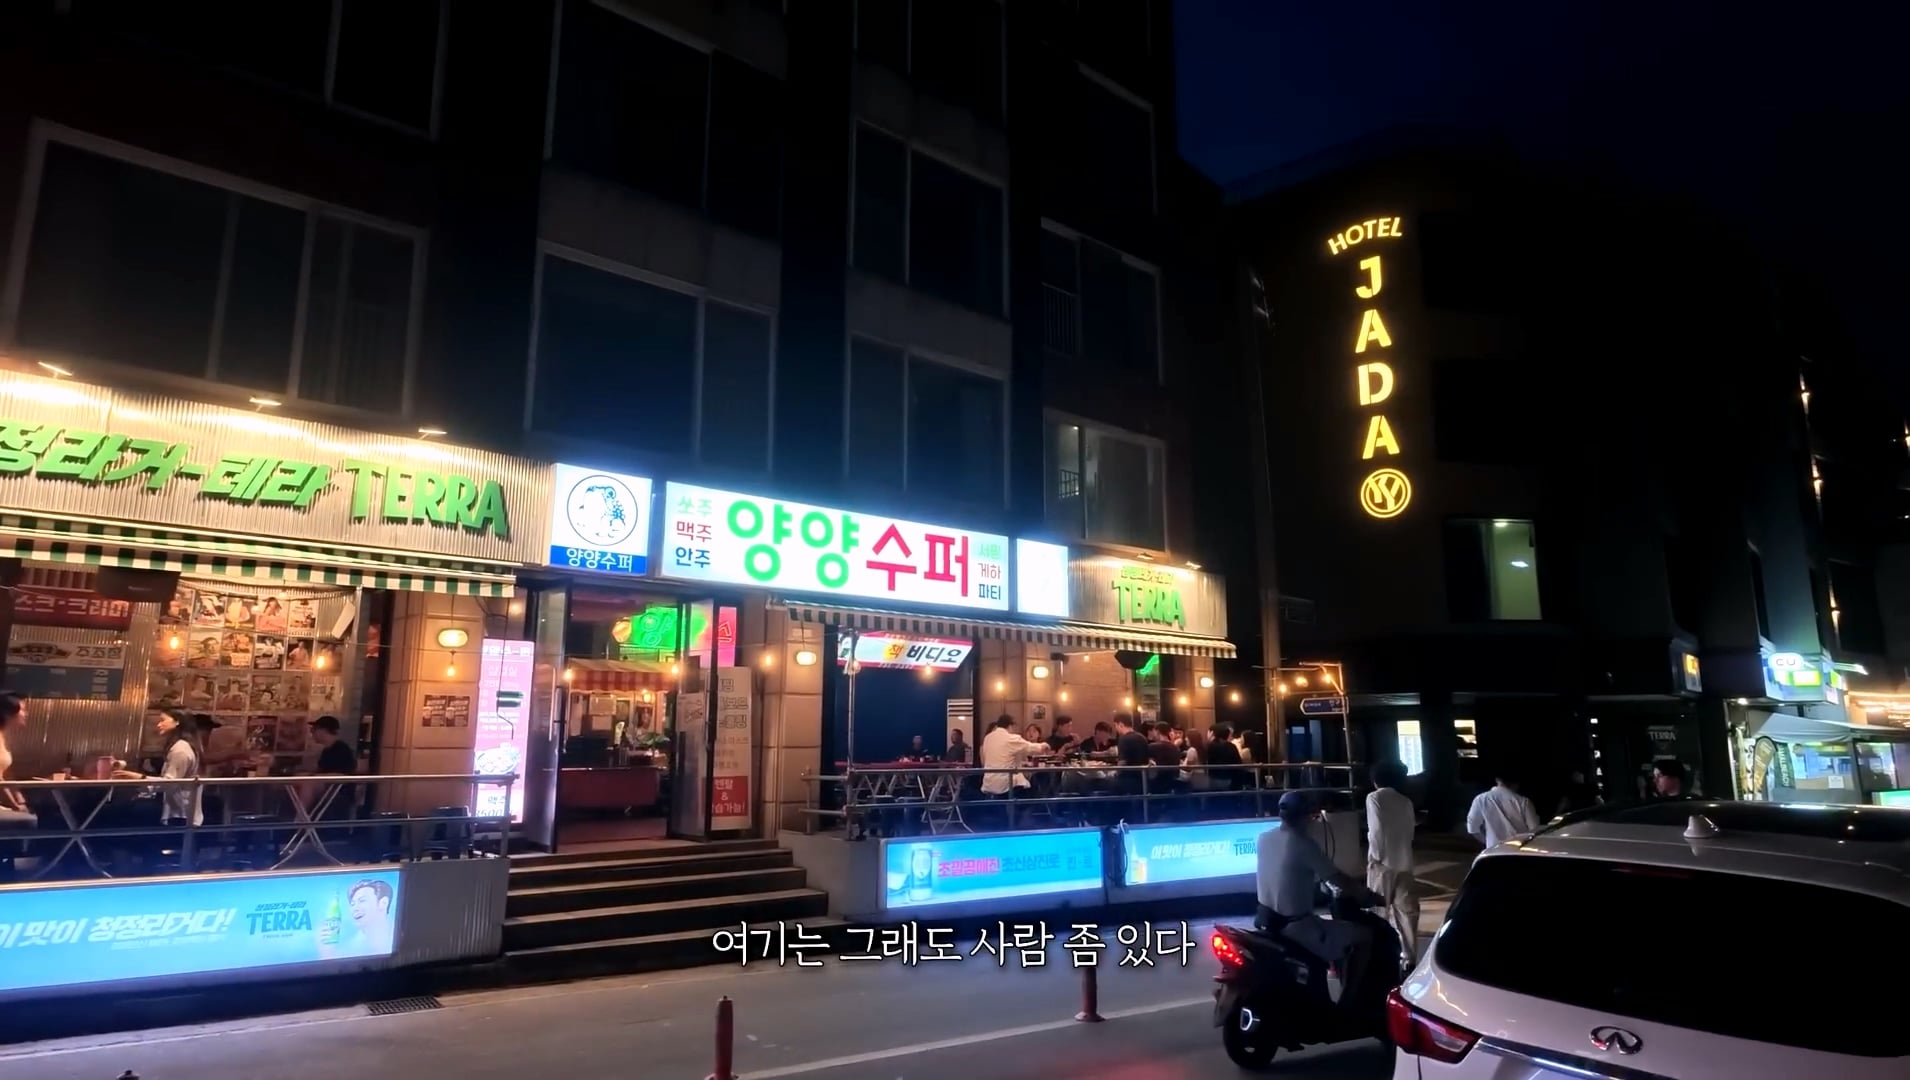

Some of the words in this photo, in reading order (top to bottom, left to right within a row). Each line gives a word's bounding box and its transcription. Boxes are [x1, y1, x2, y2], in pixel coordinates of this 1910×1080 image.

[1327, 216, 1403, 256] HOTEL
[1354, 255, 1400, 460] JADA
[345, 459, 512, 540] TERRA
[676, 520, 713, 543] 맥주
[566, 547, 633, 574] 양양수퍼
[675, 546, 711, 569] 안주
[977, 562, 1002, 580] 게하
[978, 583, 1001, 601] 파티
[1112, 581, 1186, 631] TERRA
[906, 644, 962, 664] 비디오
[17, 917, 89, 948] 맛이
[246, 909, 312, 935] TERRA
